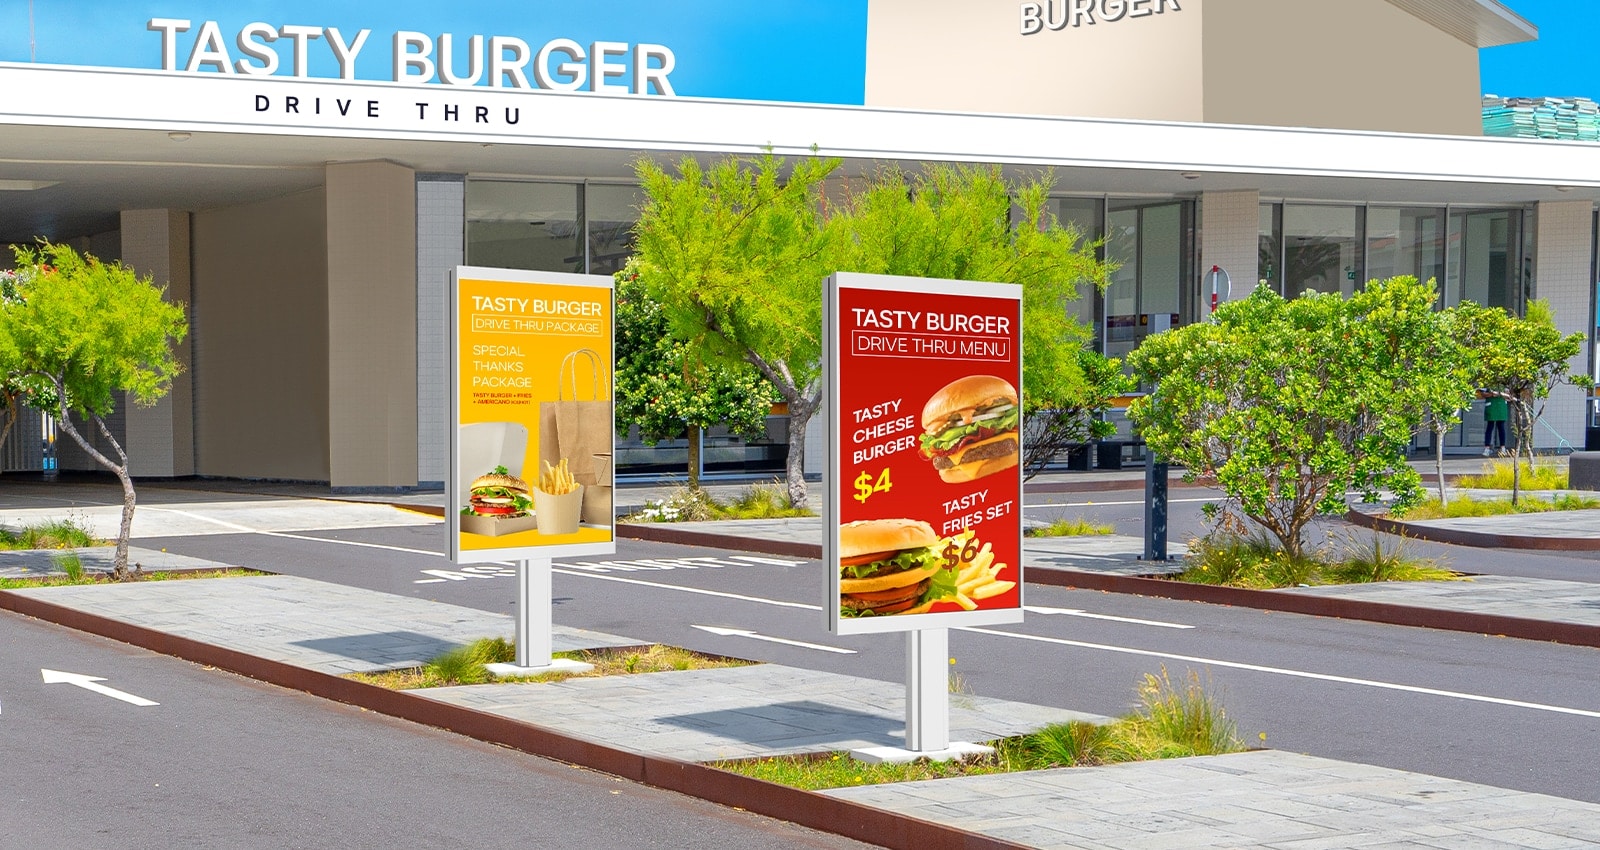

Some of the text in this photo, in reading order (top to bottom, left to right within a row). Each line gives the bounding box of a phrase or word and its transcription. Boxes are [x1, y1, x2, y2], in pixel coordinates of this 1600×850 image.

[147, 17, 677, 96] TASTY BURGER
[255, 94, 520, 125] DRIVE THRU
[472, 296, 602, 316] TASTY BURGER
[475, 318, 600, 333] DRIVE THRU PACKAGE
[852, 308, 1010, 334] TASTY BURGER
[472, 345, 525, 357] SPECIAL
[858, 336, 1006, 357] DRIVE THRU MENU
[472, 361, 524, 373] THANKS
[472, 376, 532, 388] PACKAGE
[853, 399, 902, 424] TASTY
[852, 415, 915, 444] CHEESE
[853, 435, 915, 464] BURGER
[853, 467, 893, 504] $4
[942, 489, 989, 515] TASTY
[942, 501, 1013, 535] FRIES SET
[941, 538, 977, 573] $6
